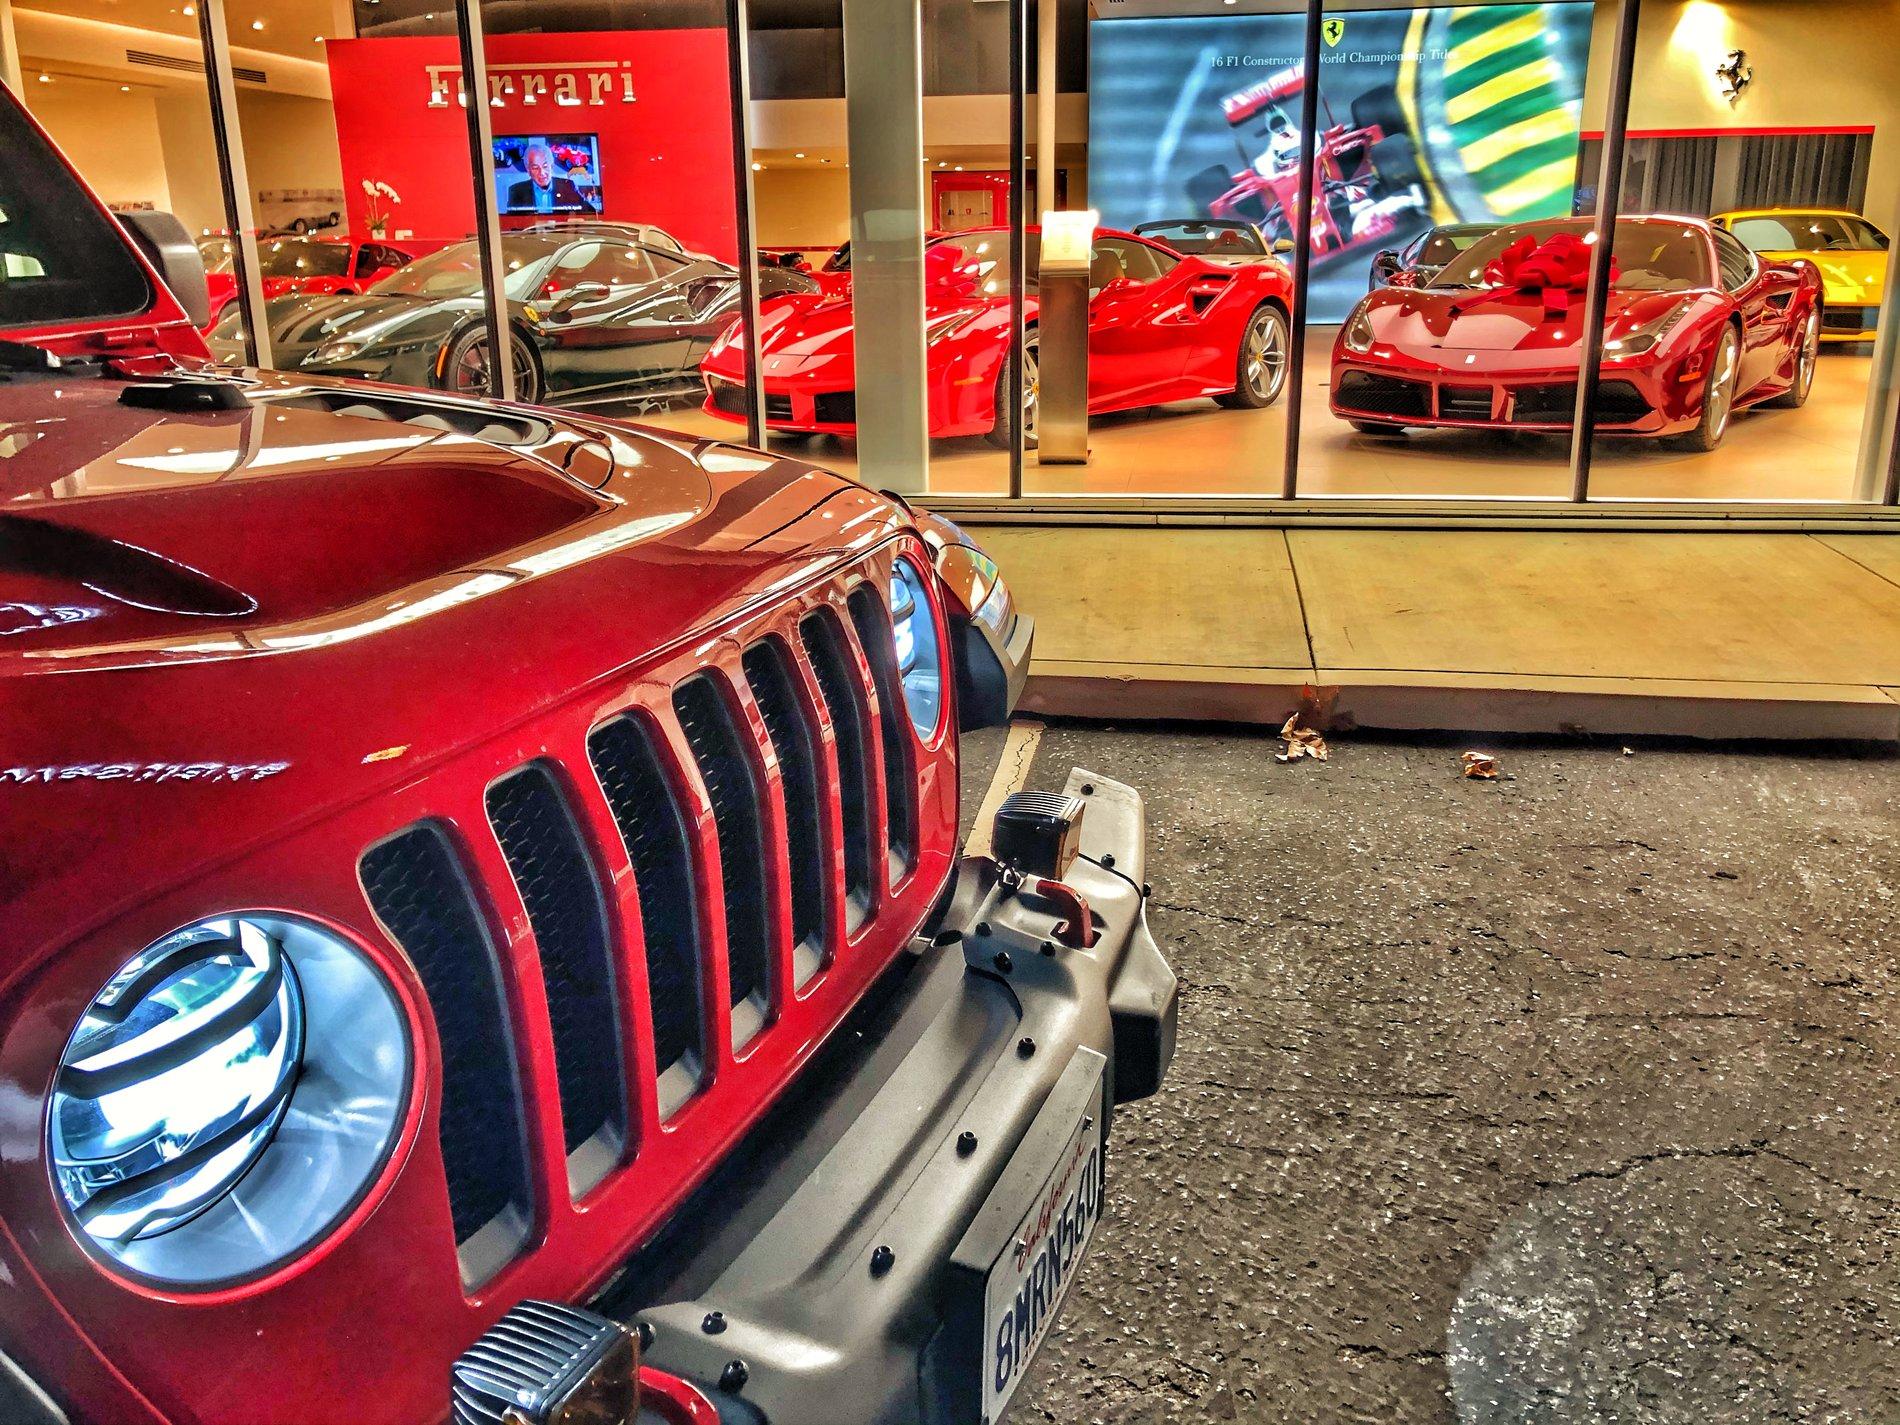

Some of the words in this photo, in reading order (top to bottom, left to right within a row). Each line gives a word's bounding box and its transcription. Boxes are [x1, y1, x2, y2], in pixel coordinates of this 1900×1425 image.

[1211, 56, 1224, 67] 16
[1226, 55, 1239, 67] F1
[1243, 55, 1306, 66] Constructor
[1349, 50, 1426, 66] Championip
[1429, 48, 1457, 61] Title
[995, 1147, 1097, 1394] 8MRN560
